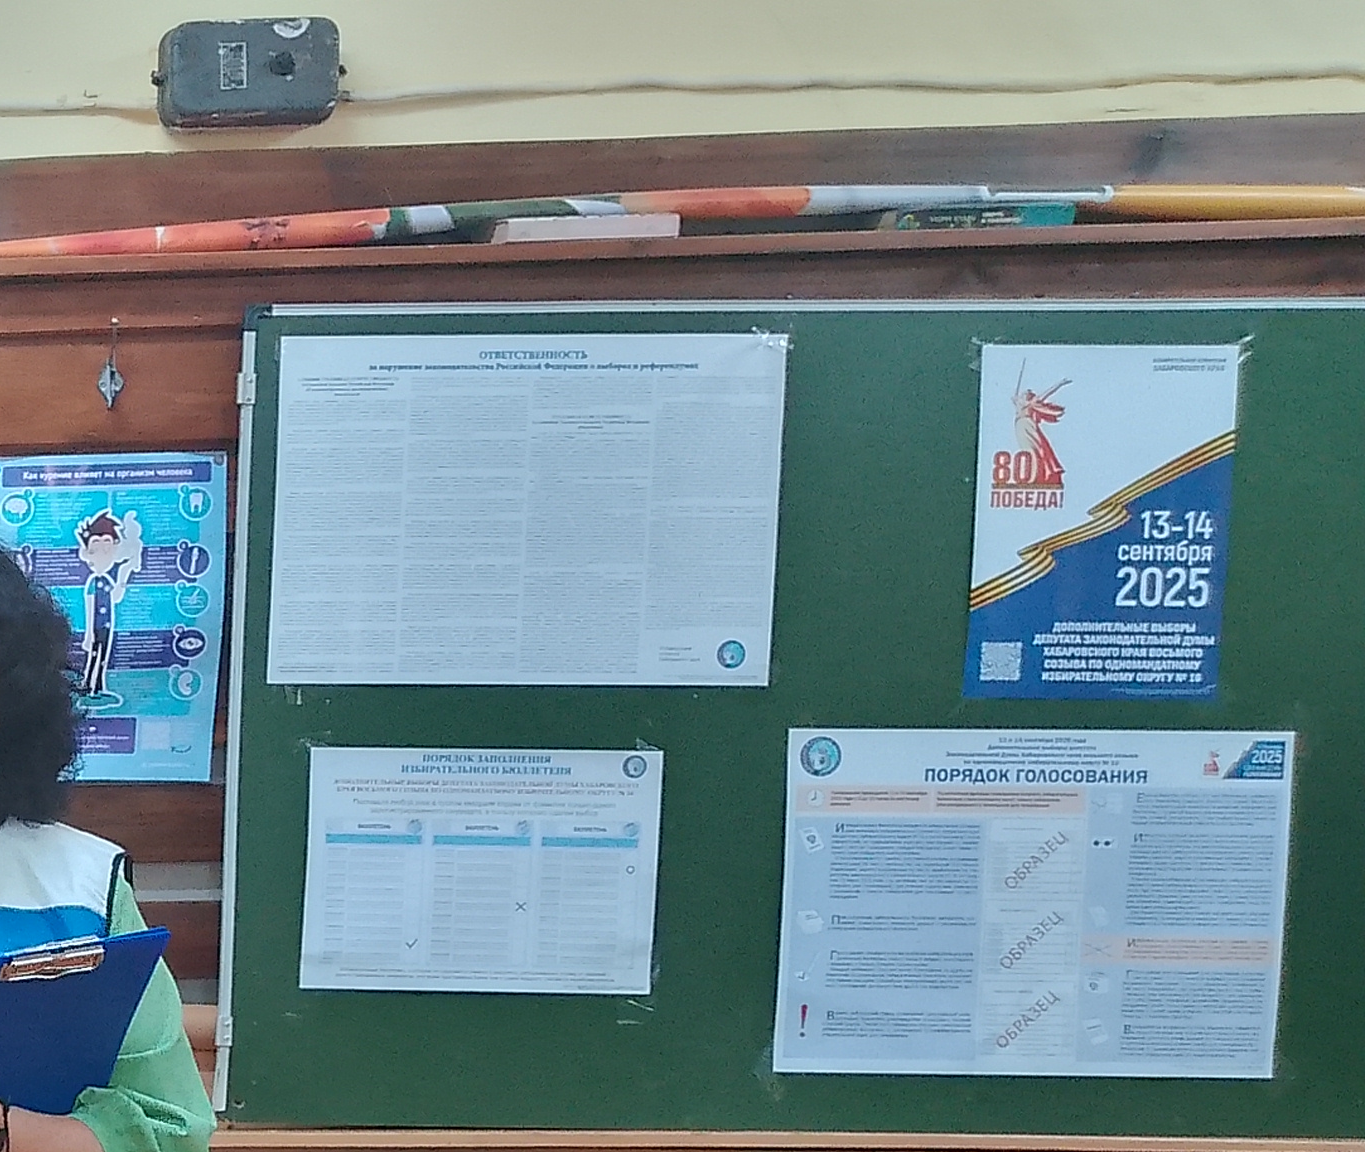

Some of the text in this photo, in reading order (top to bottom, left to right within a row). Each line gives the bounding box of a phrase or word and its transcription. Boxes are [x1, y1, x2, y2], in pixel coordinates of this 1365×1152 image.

[479, 350, 588, 360] ОТВЕТСТВЕННОСТЬ
[993, 450, 1032, 484] 80
[990, 491, 1064, 511] ПОБЕДА!
[1141, 511, 1214, 539] 13-14
[1118, 540, 1213, 565] сентября
[1115, 566, 1210, 607] 2025
[1032, 634, 1081, 645] ДЕПУТАТА
[1083, 634, 1181, 645] ЗАКОНОДАТЕЛЬНОЙ
[1043, 647, 1119, 657] ХАБАРОВСКОГО
[1044, 659, 1086, 669] СОЗЫВА
[1088, 659, 1102, 669] ПО
[422, 754, 475, 764] ПОРЯДОК
[1251, 750, 1282, 764] 2025
[925, 768, 1148, 785] ПОРЯДОК ГОЛОСОВАНИЯ
[1004, 831, 1070, 889] ОБРАЗЕЦ
[1000, 911, 1064, 969] ОБРАЗЕЦ
[996, 990, 1061, 1048] ОБРАЗЕЦ
